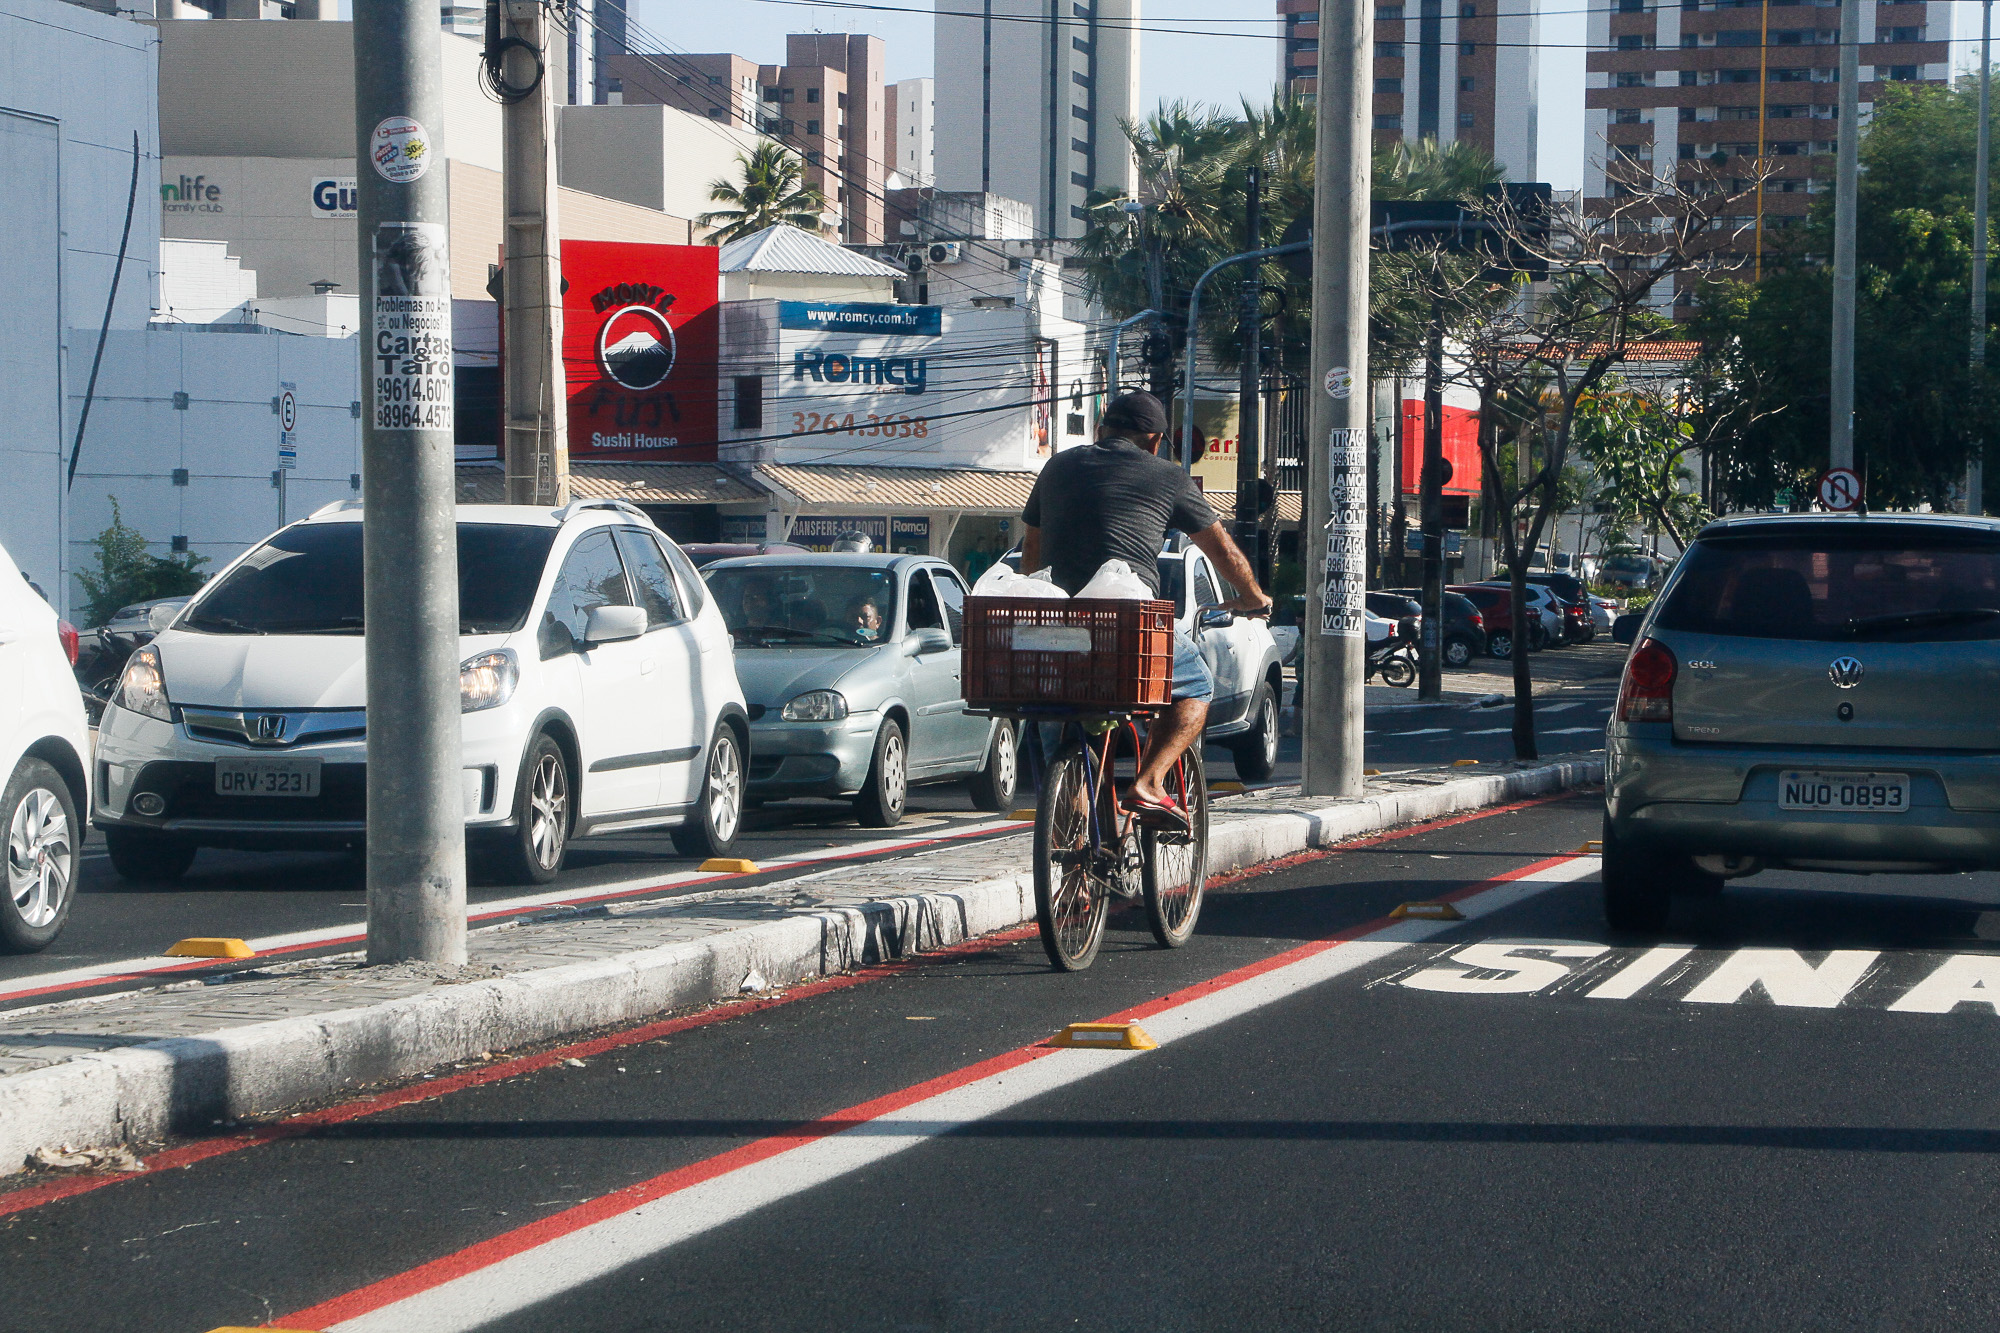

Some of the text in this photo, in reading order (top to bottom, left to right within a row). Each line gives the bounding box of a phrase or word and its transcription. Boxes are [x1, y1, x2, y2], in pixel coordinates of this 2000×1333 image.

[198, 202, 223, 213] club
[376, 296, 423, 312] Problemas
[425, 300, 435, 313] no
[591, 282, 677, 314] MONTE
[388, 316, 400, 330] ou
[806, 310, 919, 326] www.romcy.com.br
[377, 330, 450, 355] Cartas
[413, 347, 431, 363] &
[377, 355, 450, 376] Tarô
[794, 347, 926, 395] Romcy
[590, 387, 681, 428] FUJI
[791, 411, 928, 439] 3264.3638
[592, 432, 678, 449] Sushi House
[1285, 457, 1299, 467] DOG
[1349, 466, 1361, 474] SEU
[1350, 502, 1360, 510] DE
[855, 521, 885, 537] PONTO
[892, 519, 928, 535] Romcy
[1328, 535, 1365, 555] TRAGO
[1342, 572, 1355, 580] SEU
[1340, 607, 1352, 616] DE
[1324, 614, 1361, 631] VOLTA
[1688, 658, 1717, 670] GOL
[1687, 725, 1720, 735] TREND
